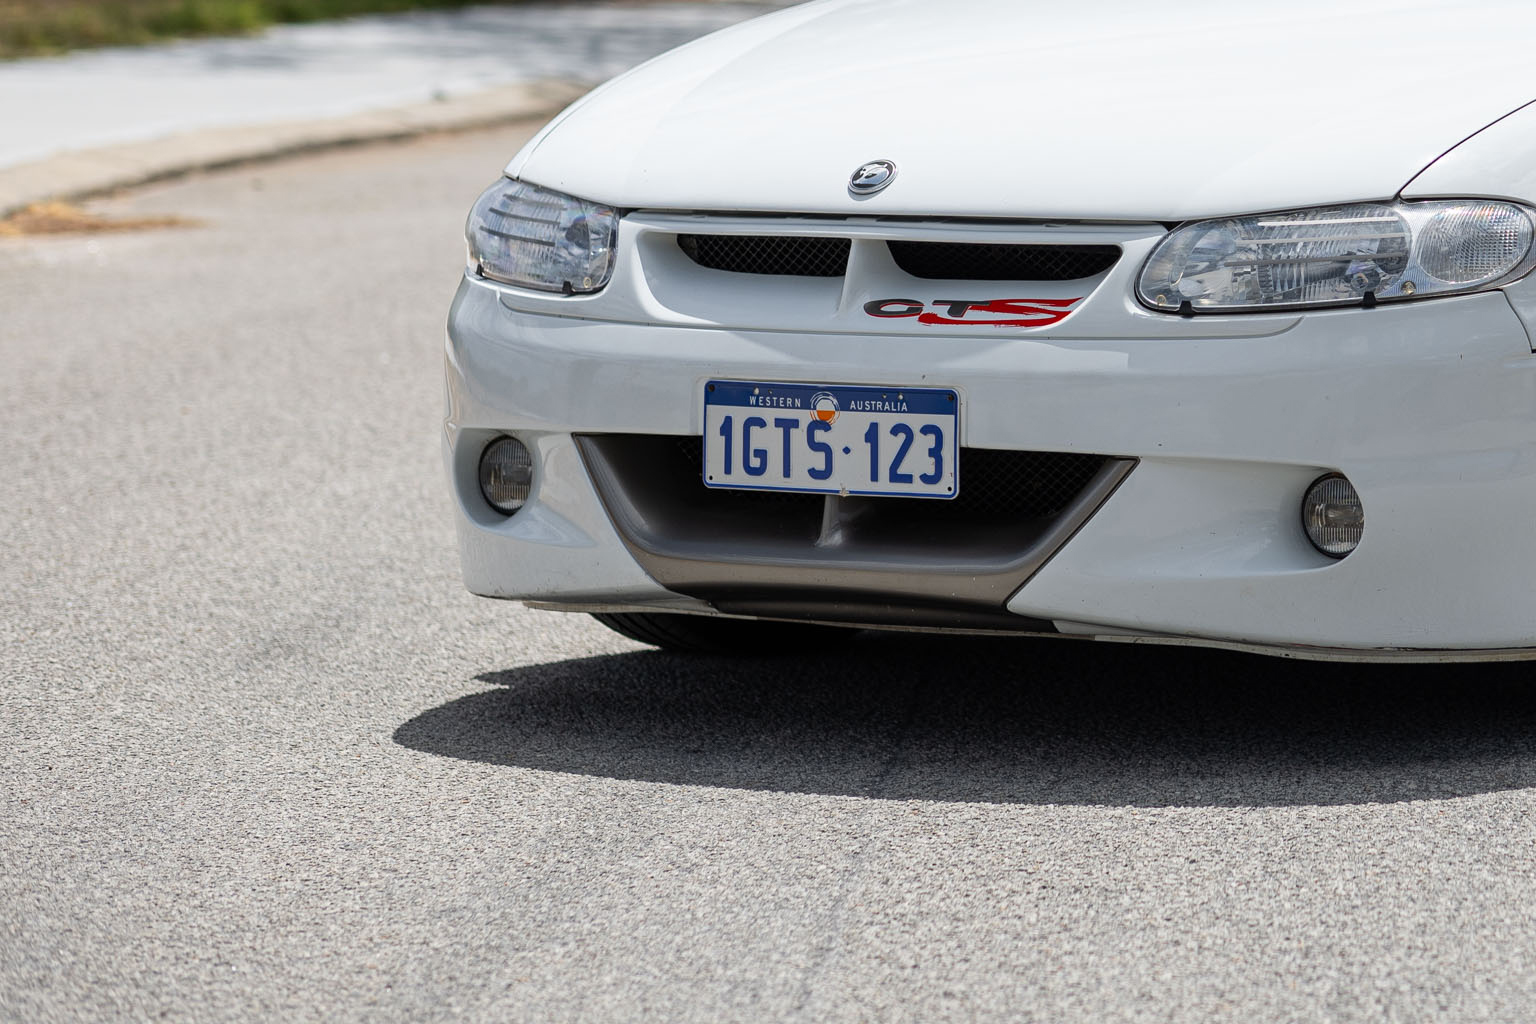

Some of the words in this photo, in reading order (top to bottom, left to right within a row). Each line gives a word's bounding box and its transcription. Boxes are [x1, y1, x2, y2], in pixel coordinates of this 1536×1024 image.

[864, 297, 1083, 328] GTS
[750, 396, 801, 408] WESTERN
[849, 400, 908, 412] AUSTRALIA
